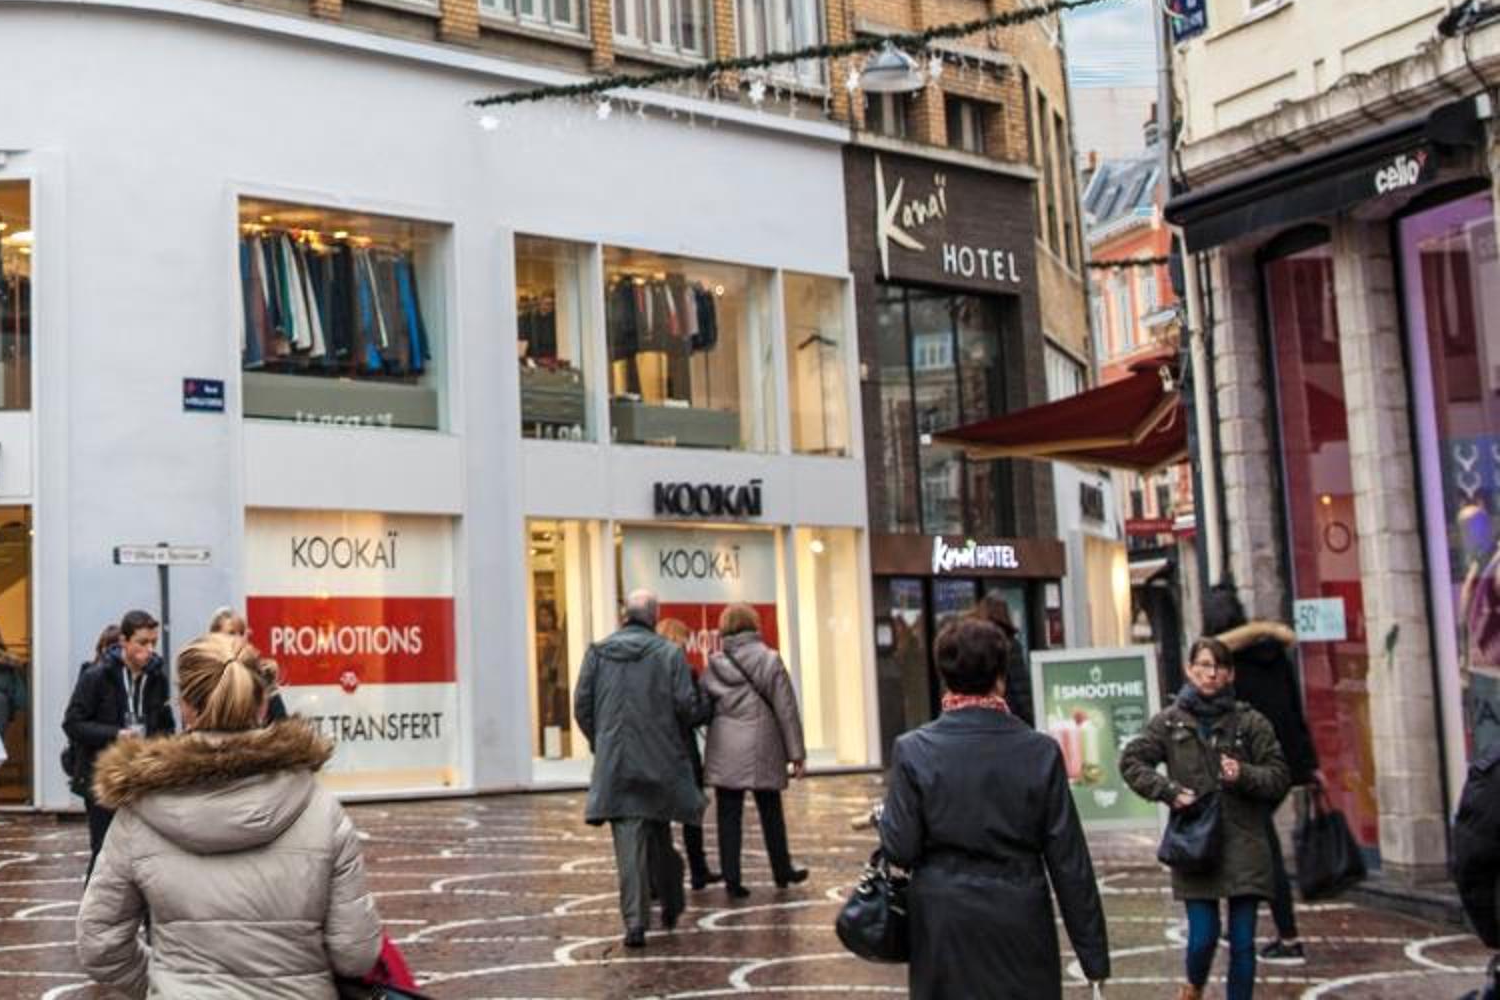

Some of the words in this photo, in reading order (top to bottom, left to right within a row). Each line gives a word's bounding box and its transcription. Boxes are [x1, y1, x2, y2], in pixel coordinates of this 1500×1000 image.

[875, 154, 947, 280] Kanaï
[943, 243, 1020, 282] HOTEL
[653, 479, 763, 517] KOOKAÏ
[291, 530, 398, 569] KOOKAÏ
[659, 545, 741, 580] KOOKAÏ
[270, 626, 423, 656] PROMOTIONS
[331, 712, 443, 742] TRANSFERT
